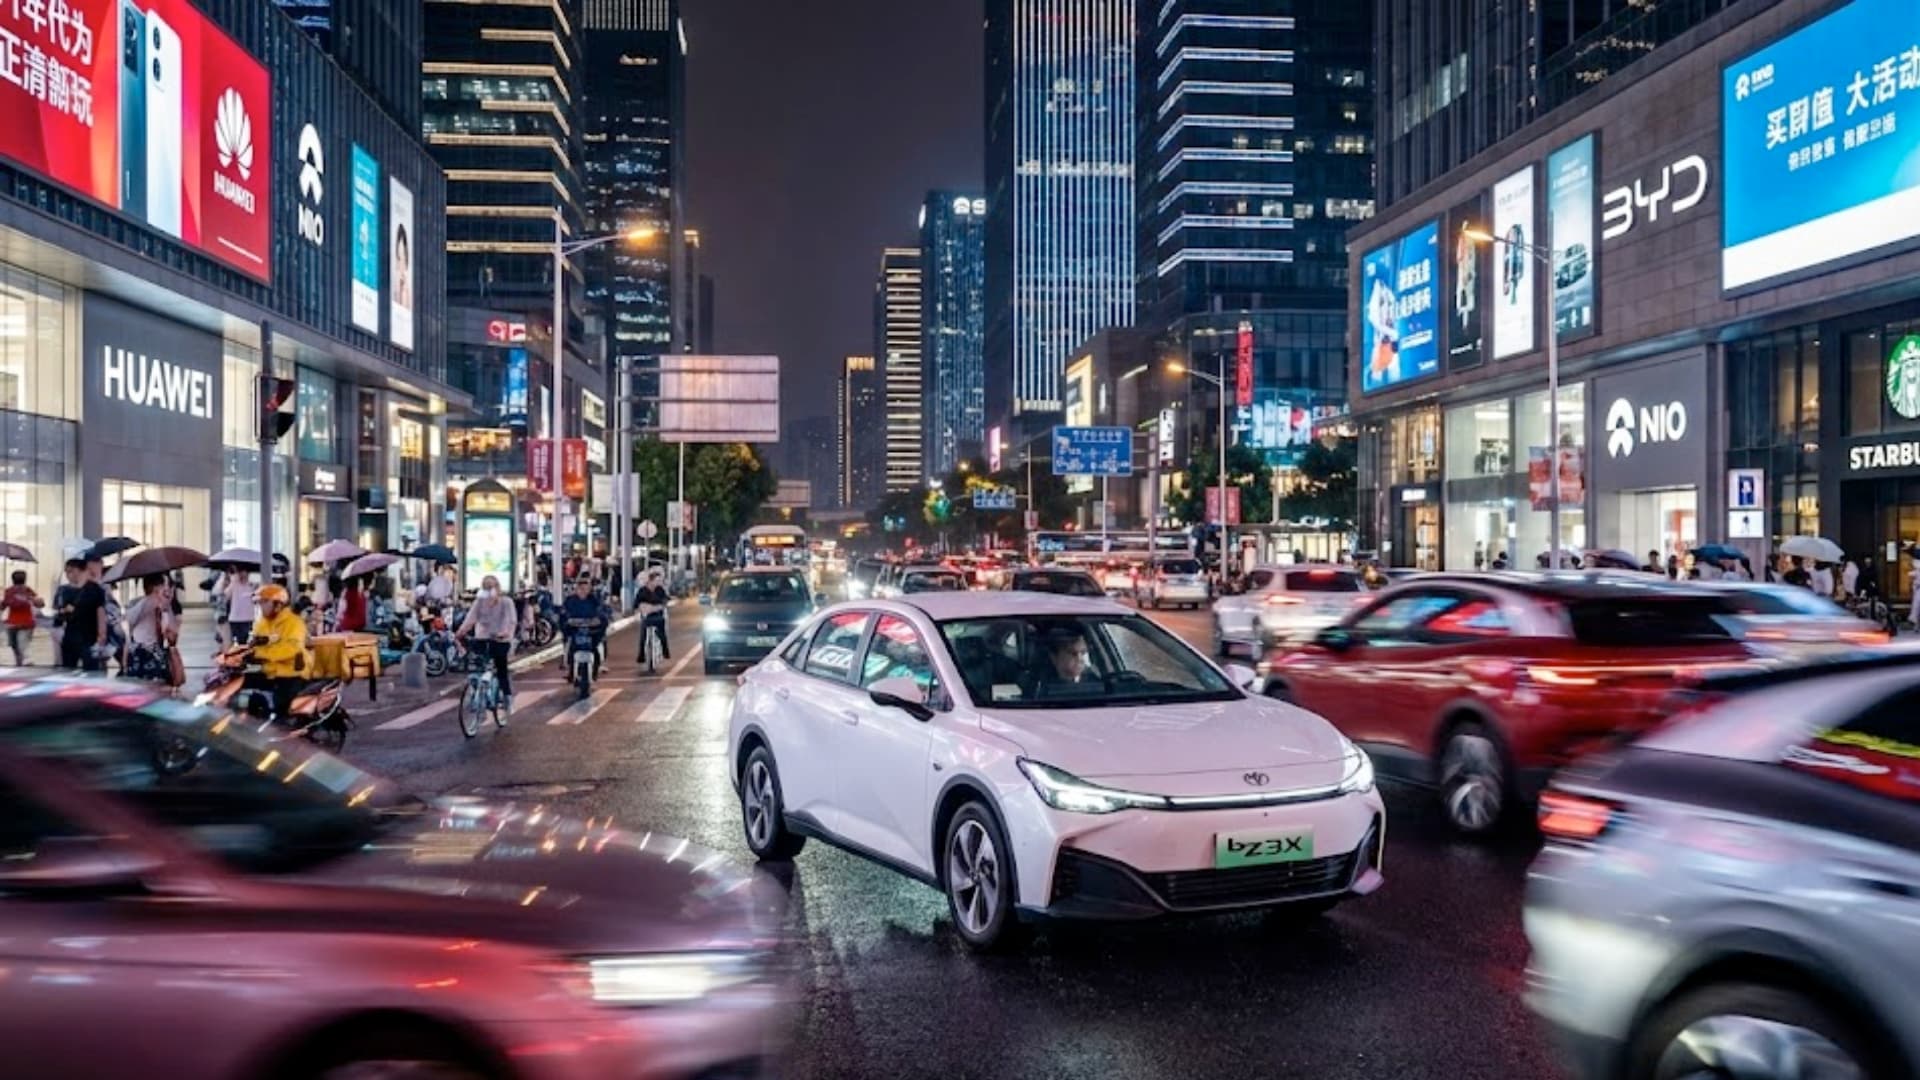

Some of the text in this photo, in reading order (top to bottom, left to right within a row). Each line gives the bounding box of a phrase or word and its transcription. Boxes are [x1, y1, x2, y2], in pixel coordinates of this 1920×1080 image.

[214, 170, 255, 215] HUAWEI
[1602, 155, 1708, 240] BYD
[298, 203, 323, 246] NIO
[104, 345, 212, 419] HUAWEI
[1640, 401, 1686, 443] NIO
